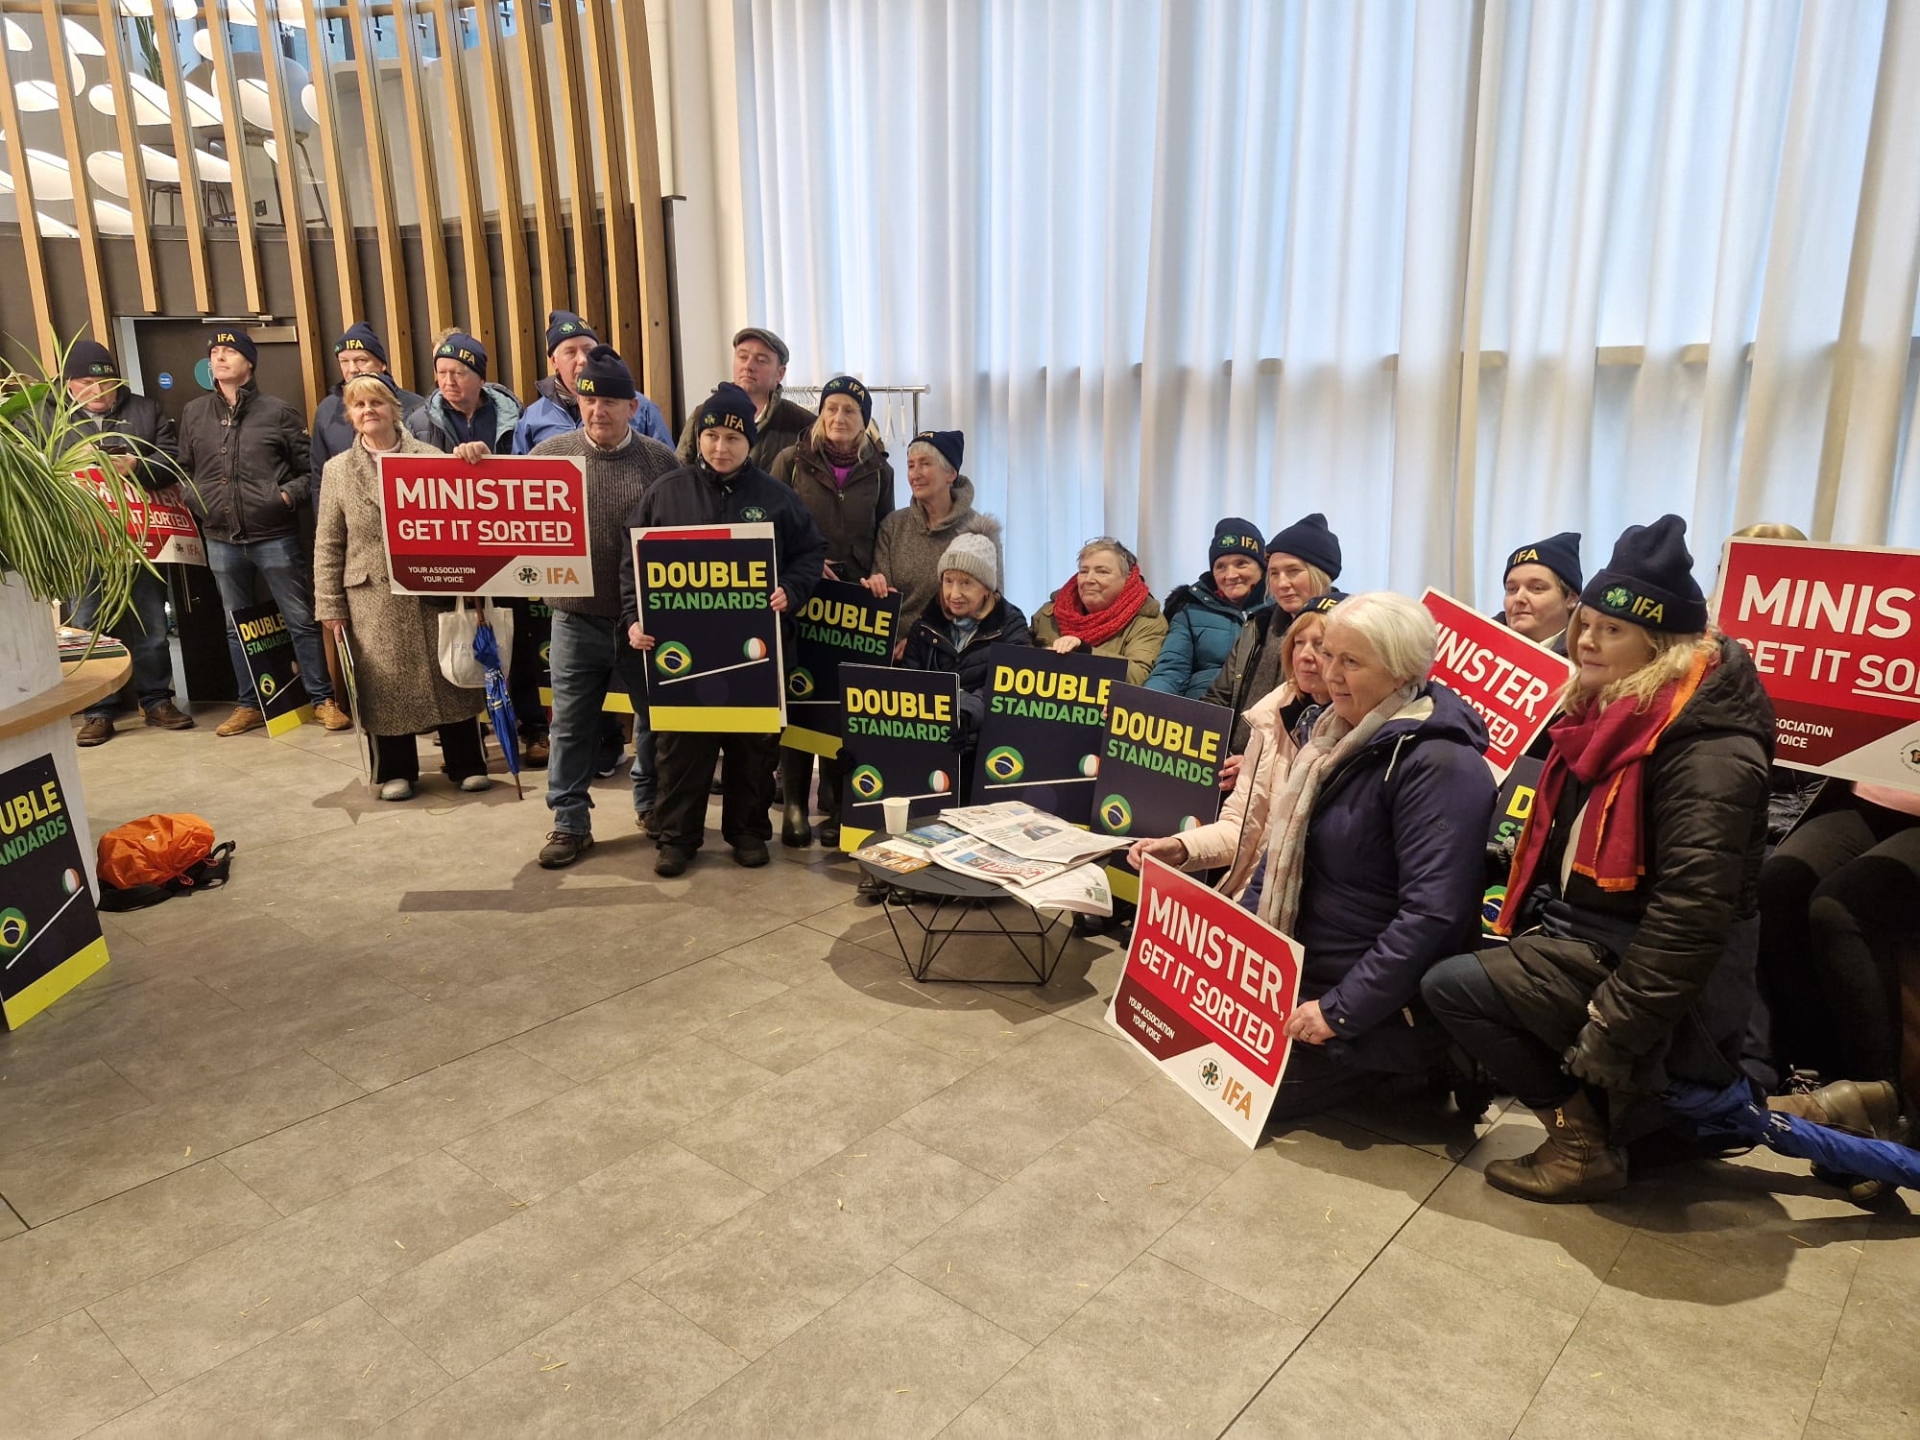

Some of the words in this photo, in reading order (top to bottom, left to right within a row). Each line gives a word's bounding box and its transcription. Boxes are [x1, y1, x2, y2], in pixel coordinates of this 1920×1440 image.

[216, 333, 236, 343] IFA
[345, 339, 364, 350] IFA
[458, 348, 476, 365] IFA
[581, 379, 595, 392] IFA
[847, 382, 866, 401] IFA
[723, 412, 745, 433] IFA
[394, 477, 577, 515] MINISTER,
[398, 519, 445, 541] GET
[451, 519, 472, 541] IT
[478, 520, 572, 543] SORTED
[1240, 535, 1260, 553] IFA
[187, 545, 201, 556] IFA
[1512, 548, 1539, 564] IFA
[408, 566, 428, 574] YOUR
[429, 566, 476, 574] ASSOCIATION
[422, 576, 442, 584] YOUR
[443, 576, 464, 584] VOICE
[546, 567, 579, 585] IFA
[647, 561, 767, 588] DOUBLE
[648, 592, 768, 610] STANDARDS
[1316, 597, 1339, 611] IF
[1630, 594, 1664, 624] IFA
[1737, 574, 1920, 640] MINIS
[239, 612, 288, 642] DOUBLE
[796, 597, 893, 637] OUBLE
[799, 622, 887, 656] TANDARDS
[994, 665, 1112, 706] DOUBLE
[1810, 647, 1851, 683] IT
[1854, 654, 1920, 696] SO
[846, 687, 952, 721] DOUBLE
[1450, 687, 1519, 748] TED
[848, 716, 951, 743] STANDARDS
[1110, 706, 1220, 763] DOUBLE
[1775, 718, 1834, 738] OCIATION
[1107, 739, 1215, 787] STANDARDS
[0, 780, 62, 835] UBLE
[0, 815, 68, 866] ANDARDS
[1147, 887, 1286, 1021] MINISTER,
[1138, 938, 1175, 980] GET
[1172, 957, 1195, 996] IT
[1192, 977, 1276, 1056] SORTED
[1128, 994, 1143, 1013] YOUR
[1140, 1006, 1176, 1040] ASSOCIATION
[1132, 1013, 1147, 1031] YOUR
[1145, 1024, 1163, 1044] VOICE
[1221, 1076, 1253, 1121] IFA
